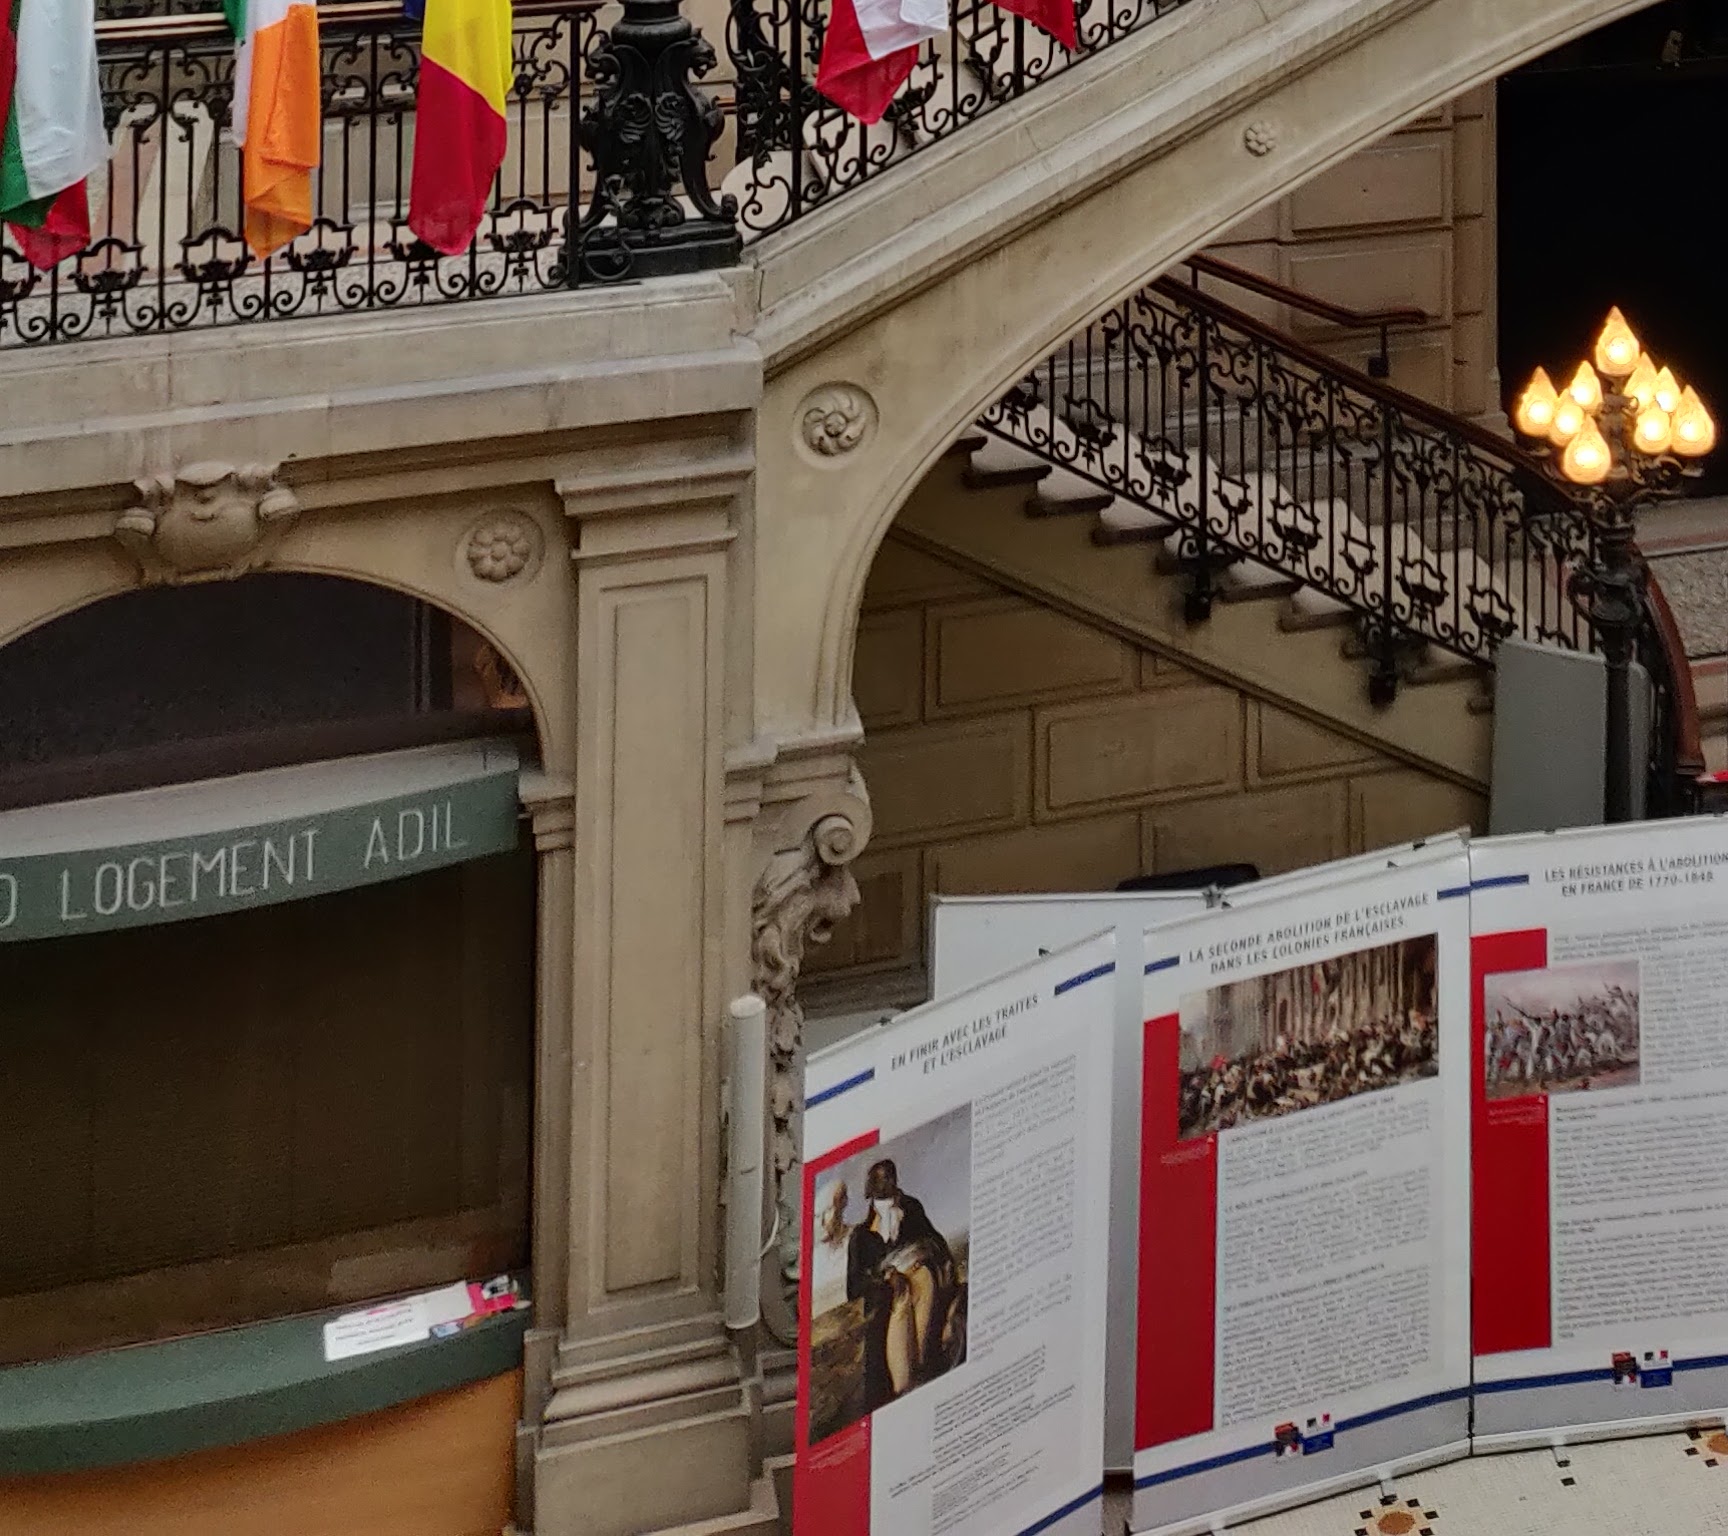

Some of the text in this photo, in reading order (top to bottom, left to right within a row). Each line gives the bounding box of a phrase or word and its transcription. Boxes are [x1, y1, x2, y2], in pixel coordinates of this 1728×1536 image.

[59, 829, 320, 921] LOGEMENT
[364, 799, 468, 870] ADIL
[1544, 868, 1566, 884] LES
[1581, 879, 1624, 897] FRANCE
[1188, 949, 1204, 964] LA
[1208, 934, 1262, 960] SECONDE
[1210, 957, 1243, 975] DANS
[1246, 950, 1269, 966] LES
[1272, 936, 1330, 961] COLONIES
[891, 1053, 906, 1072] EN
[942, 1025, 969, 1049] AVEC
[923, 1057, 937, 1076] ET
